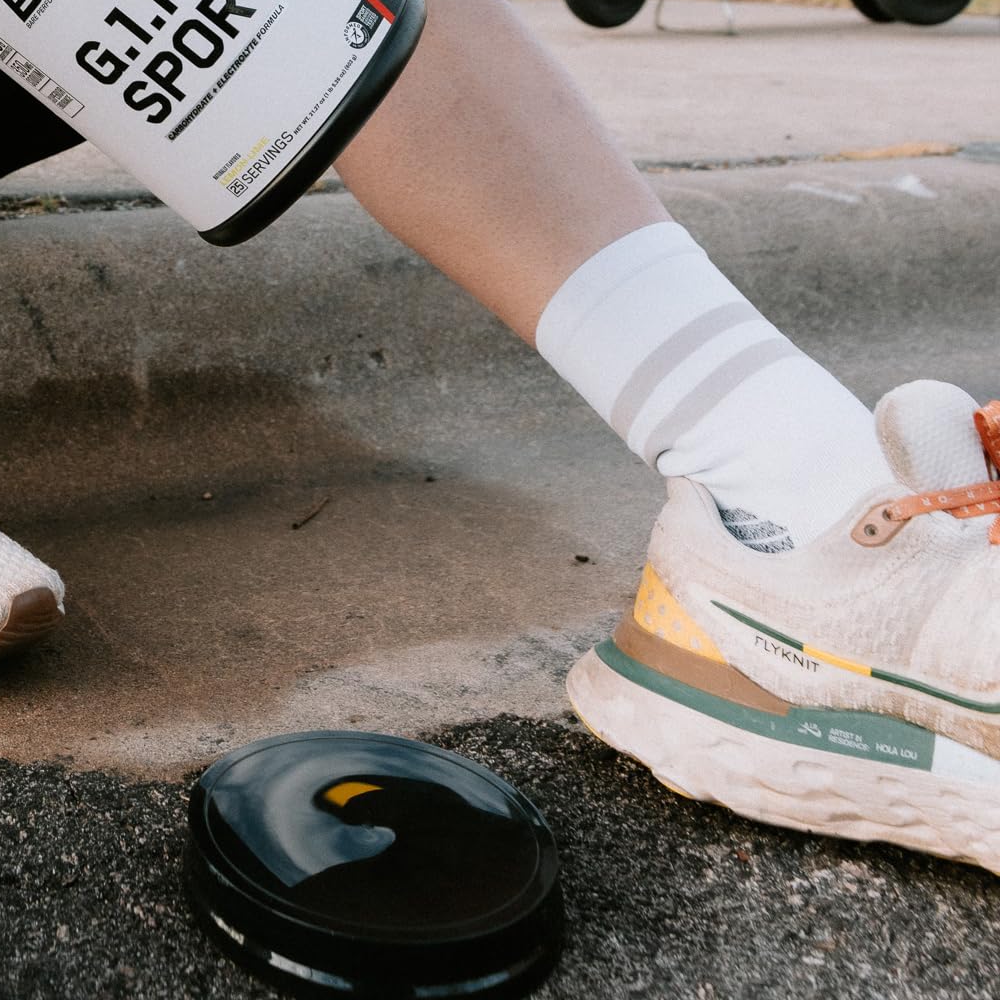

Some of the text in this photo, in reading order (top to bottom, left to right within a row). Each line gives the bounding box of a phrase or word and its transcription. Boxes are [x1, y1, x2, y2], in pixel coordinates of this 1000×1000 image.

[26, 14, 39, 29] BARE
[168, 92, 213, 141] CARBOHYDRATE
[216, 38, 259, 89] ELECTROLYTE
[256, 4, 285, 40] FORMULA
[230, 181, 245, 195] 25
[241, 131, 294, 184] SERVINGS
[293, 123, 304, 135] NET
[754, 635, 820, 673] FLYKNIT
[876, 743, 918, 761] HOLA LOU
